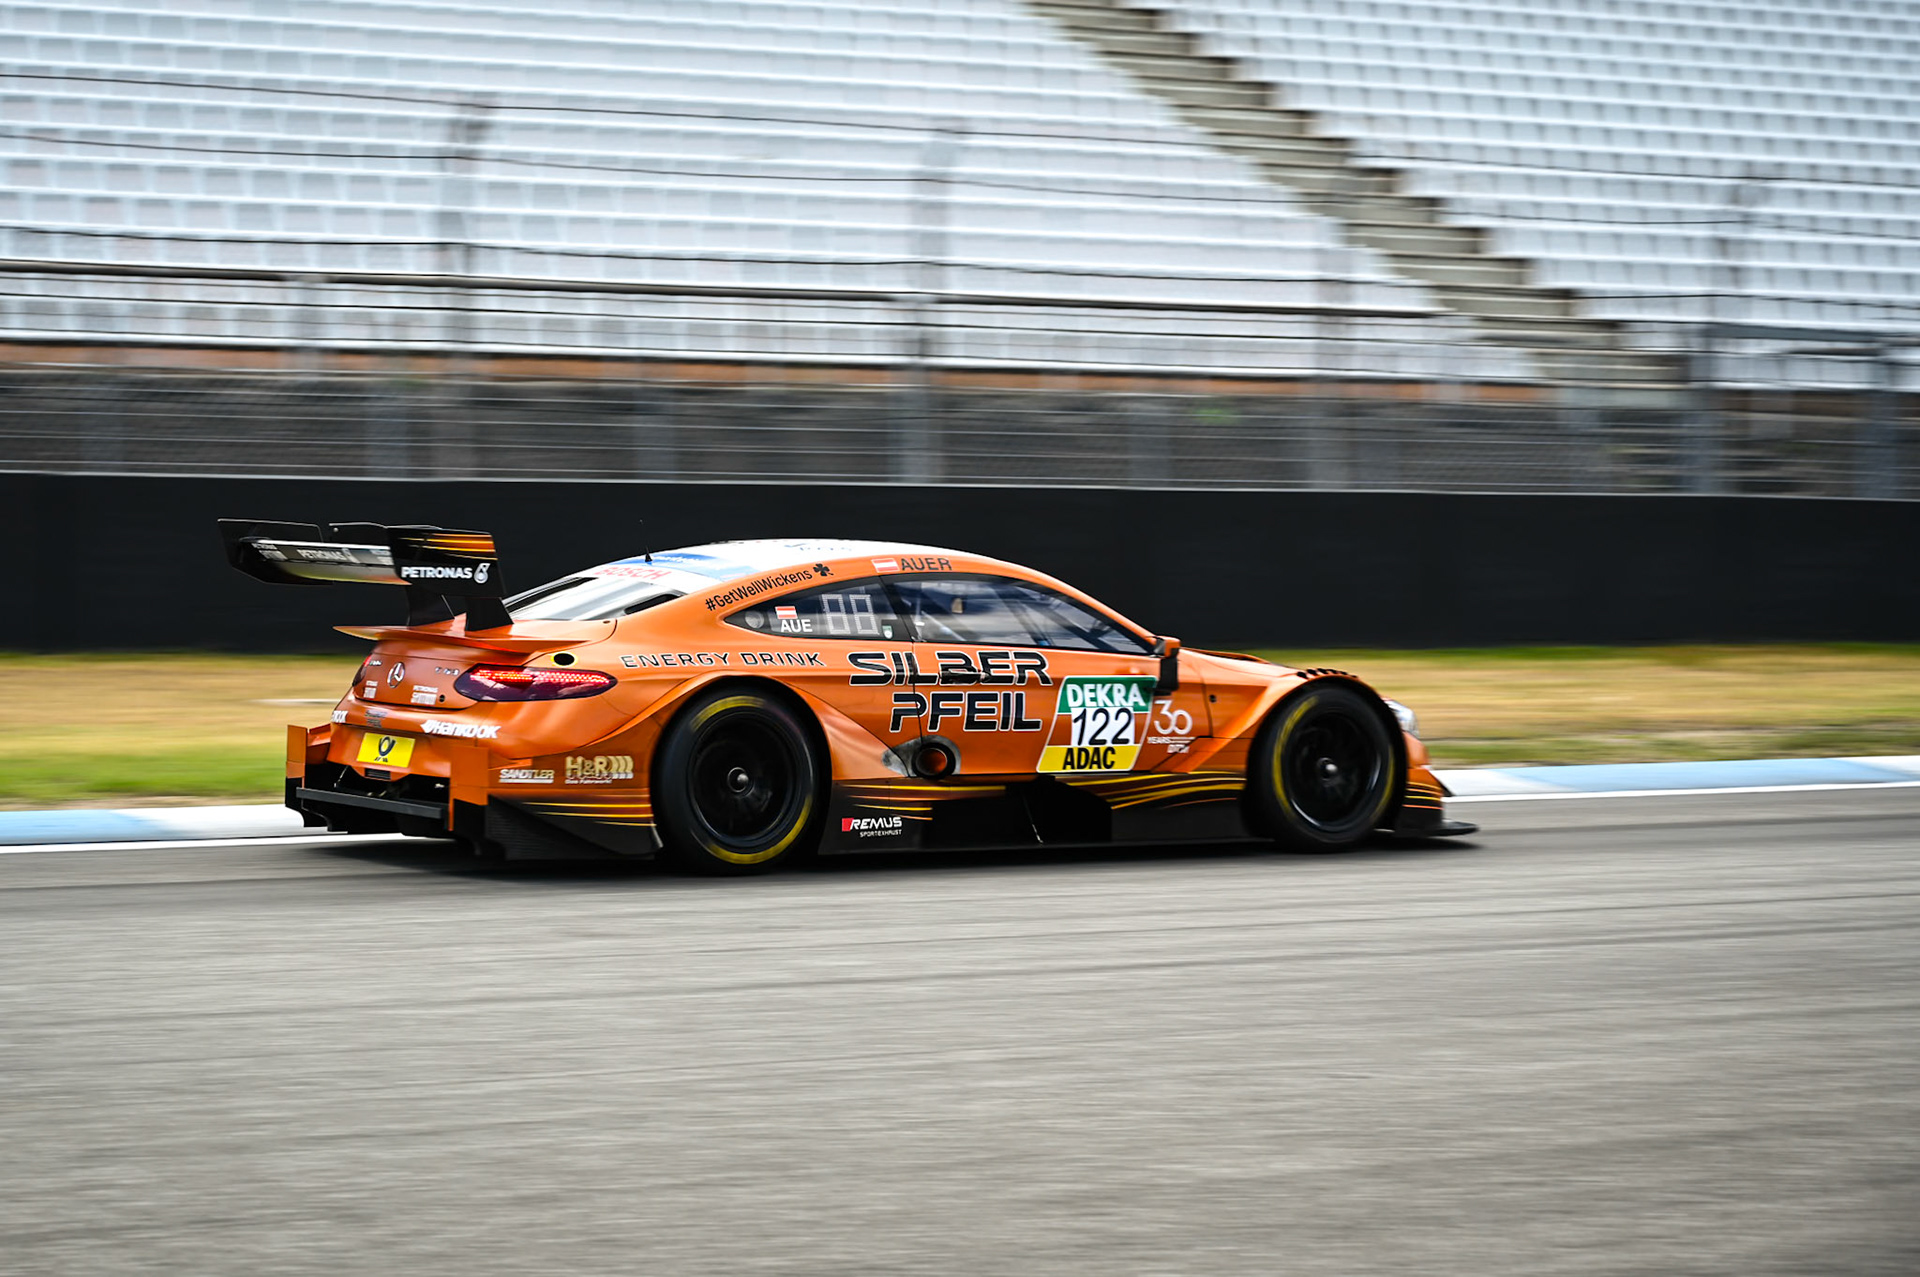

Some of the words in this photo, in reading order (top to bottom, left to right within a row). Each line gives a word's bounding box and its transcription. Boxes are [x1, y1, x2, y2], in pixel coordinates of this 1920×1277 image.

[401, 566, 473, 579] PETRONAS
[594, 566, 672, 580] BOSCH
[901, 558, 953, 571] AUER
[705, 569, 813, 611] #GetWellWickens
[780, 619, 813, 633] AUE
[620, 652, 730, 668] ENERGY
[738, 652, 827, 667] DRINK
[848, 651, 1053, 686] SILBER
[1066, 683, 1146, 708] DEKRA
[889, 692, 1043, 733] PFEIL
[1154, 700, 1193, 735] 30
[1072, 707, 1134, 746] 122
[1062, 747, 1116, 770] ADAC
[499, 769, 555, 779] SANDTLER
[850, 817, 902, 830] REMUS
